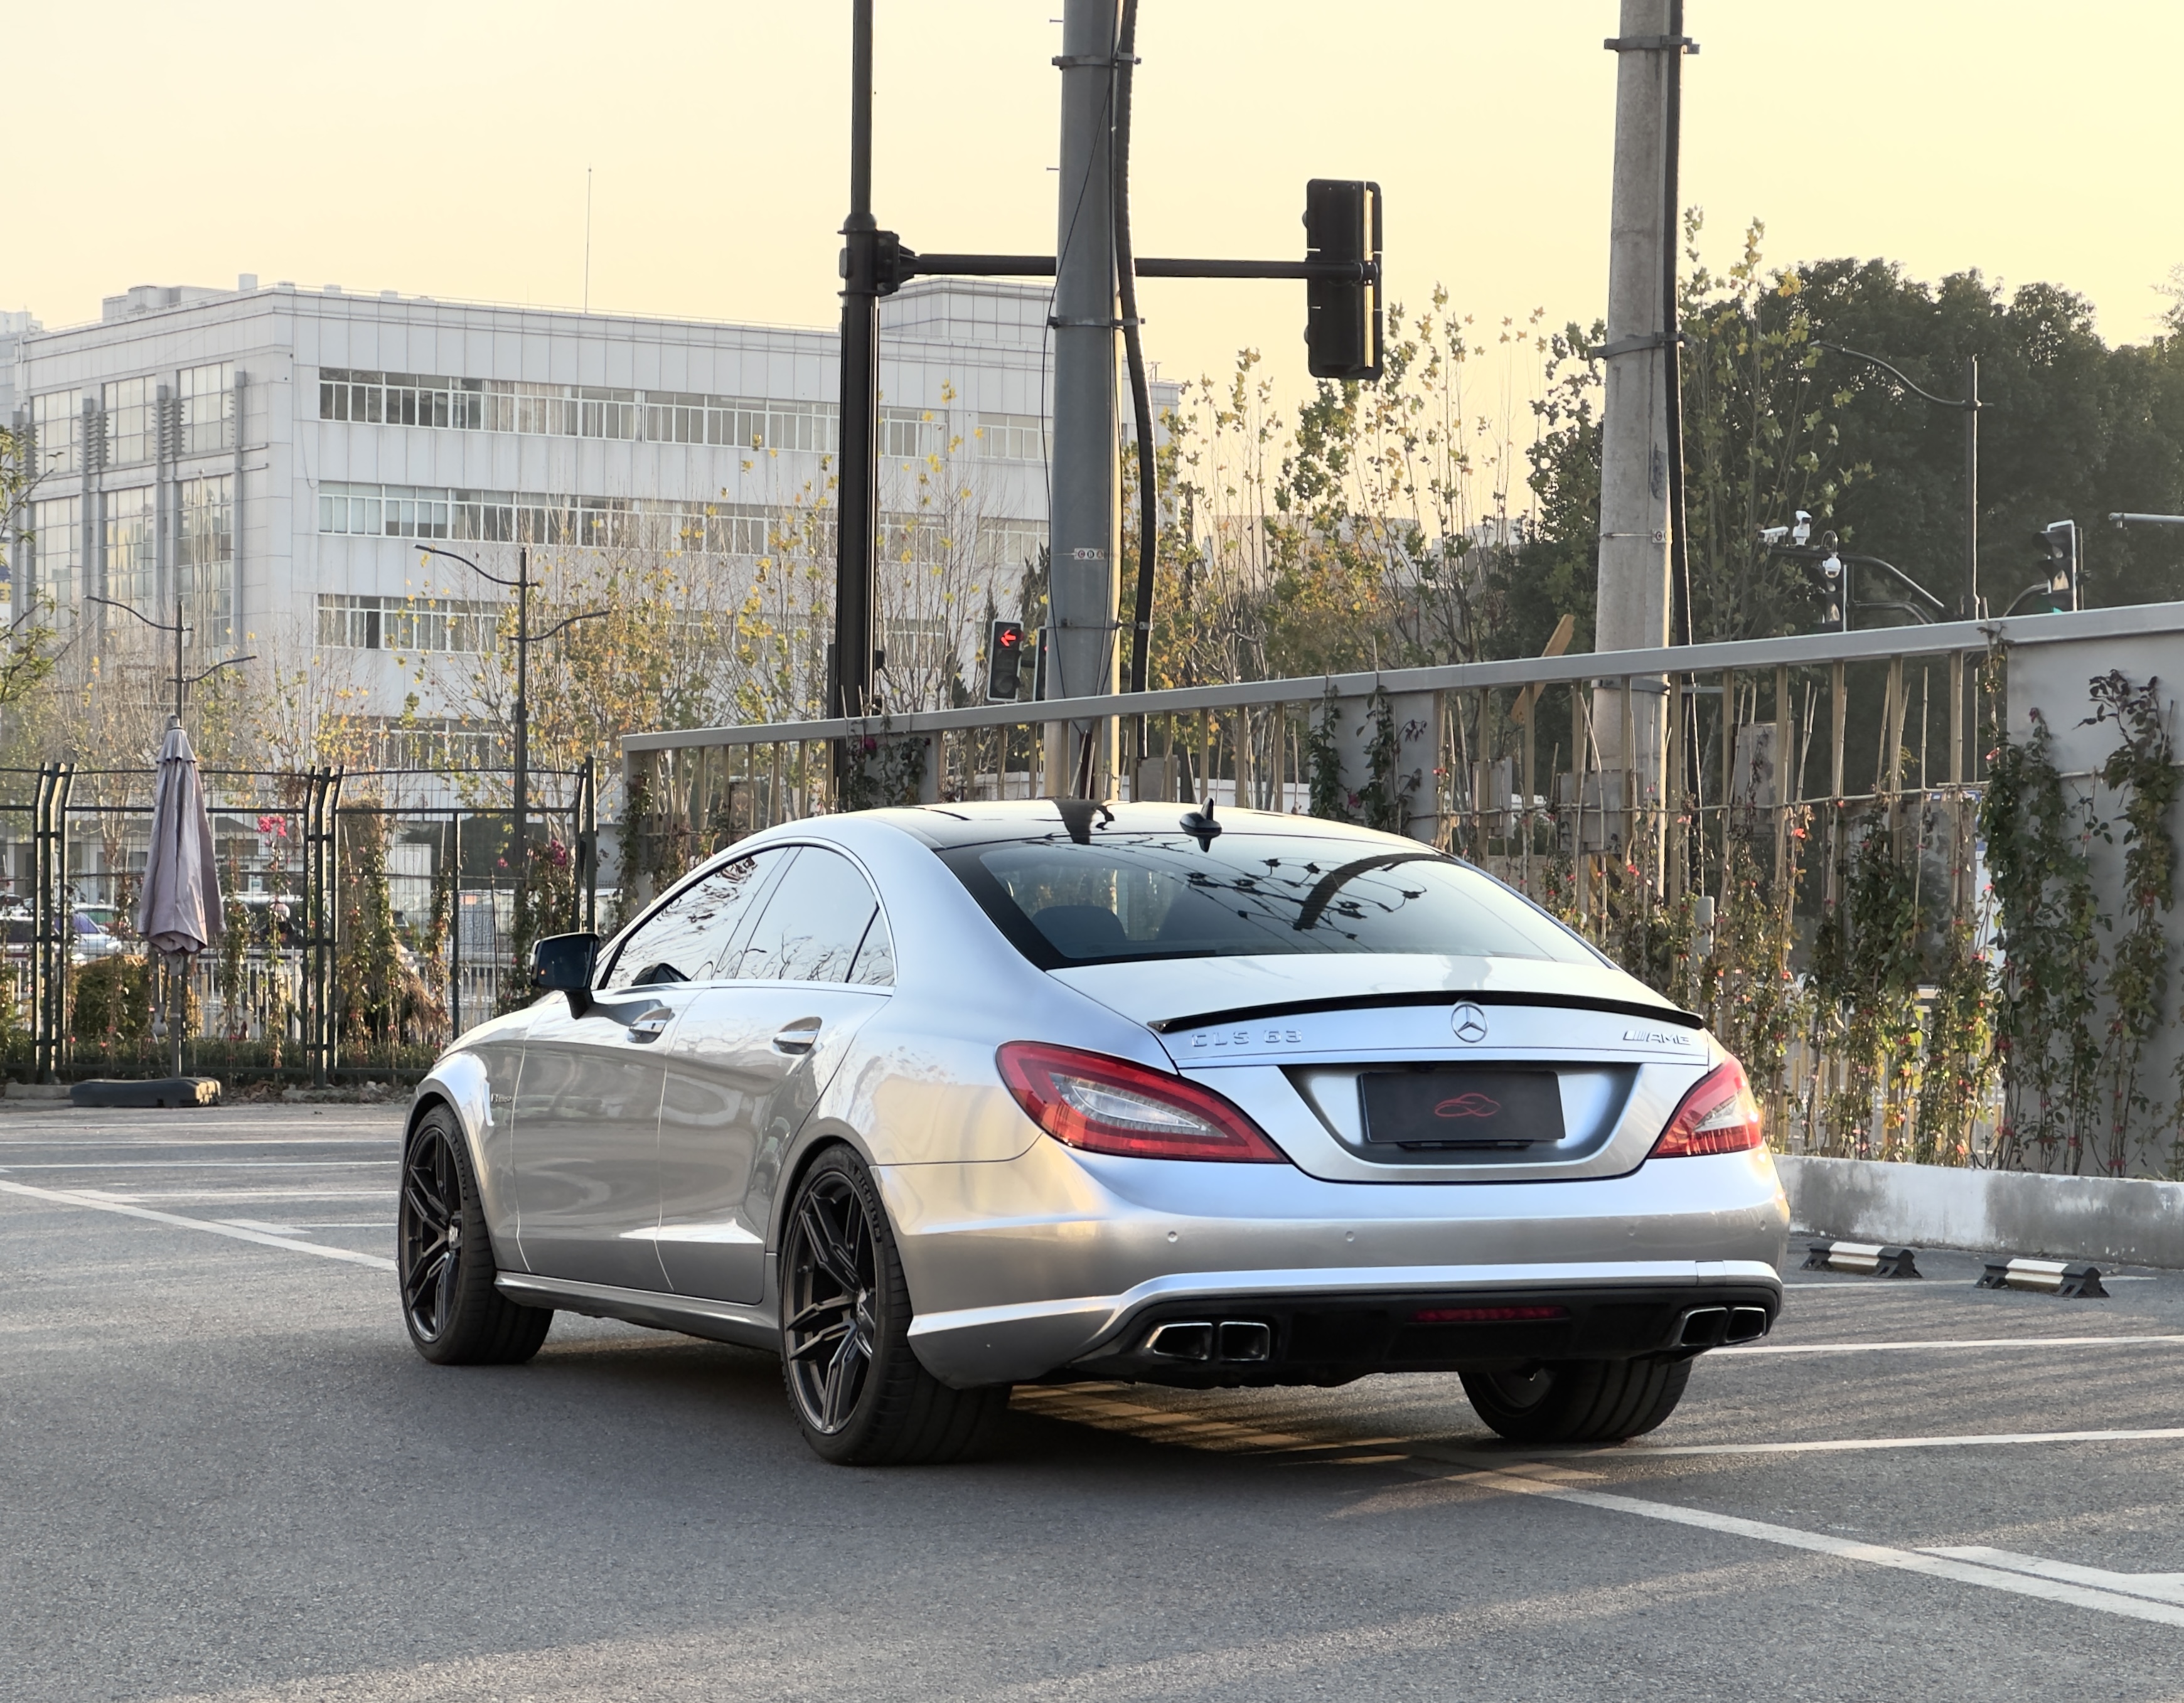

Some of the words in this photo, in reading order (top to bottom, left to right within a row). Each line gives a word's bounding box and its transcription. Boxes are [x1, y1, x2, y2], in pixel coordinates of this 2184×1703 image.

[1191, 1031, 1250, 1047] CLS
[1264, 1030, 1302, 1044] 63
[1646, 1032, 1692, 1045] AMG
